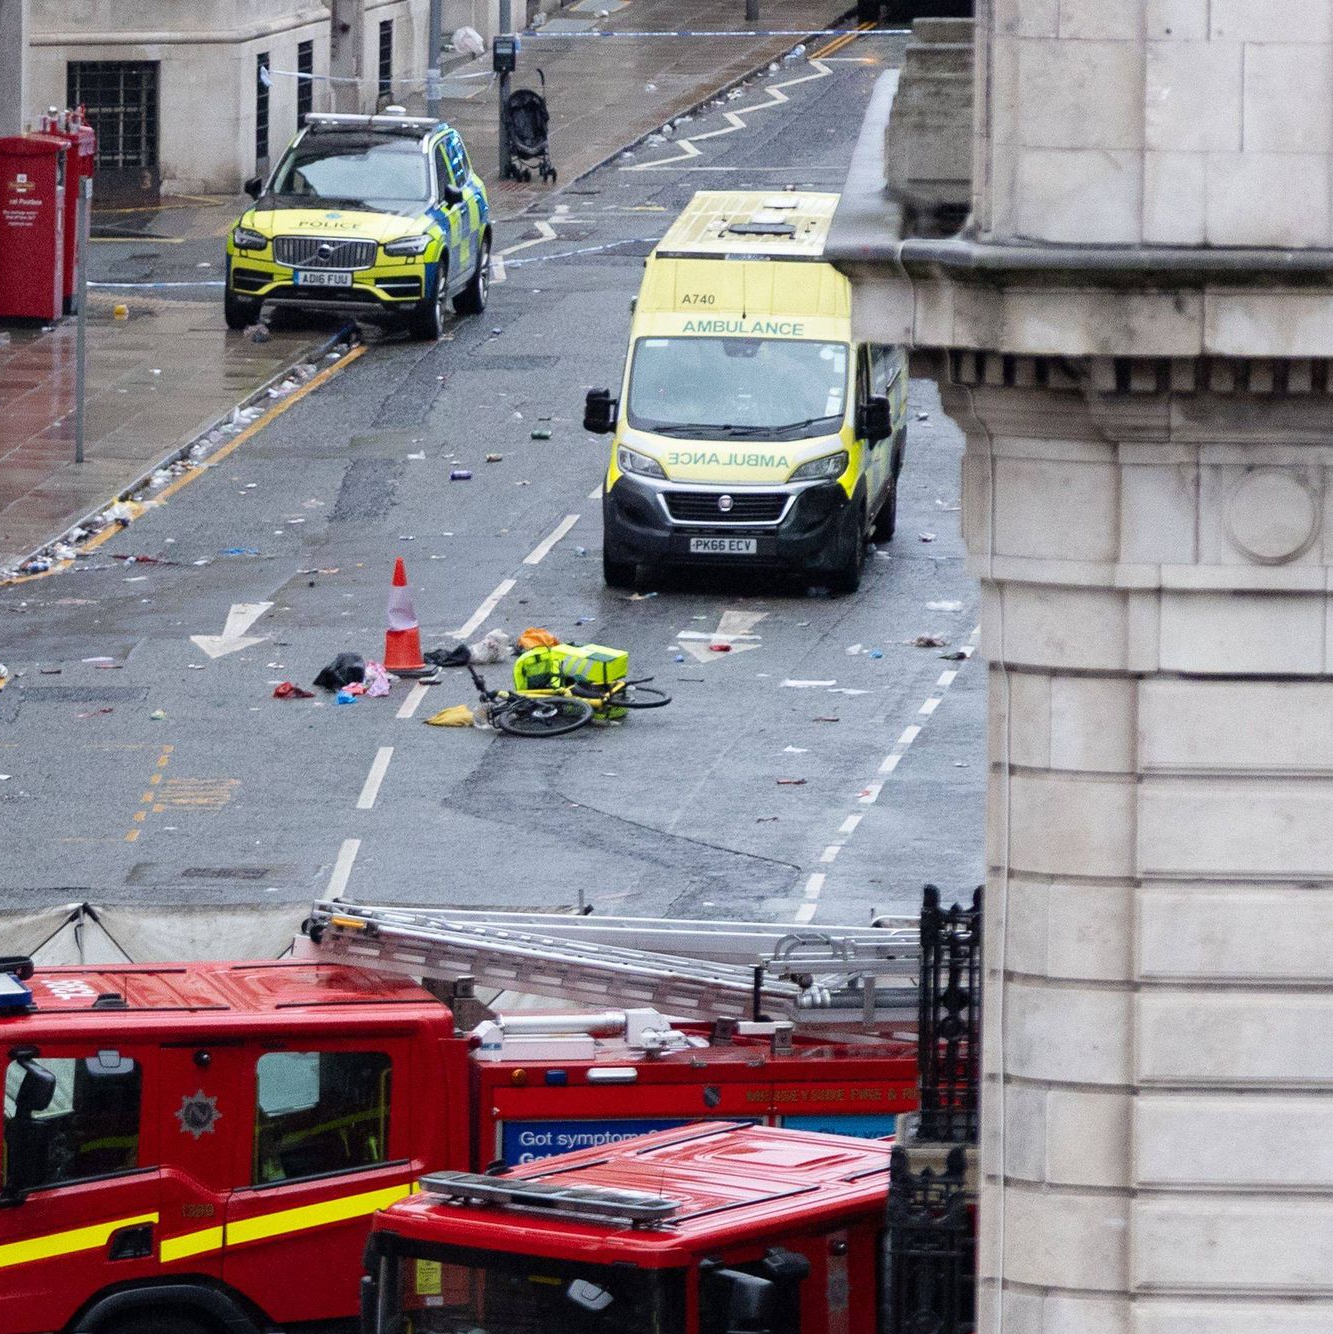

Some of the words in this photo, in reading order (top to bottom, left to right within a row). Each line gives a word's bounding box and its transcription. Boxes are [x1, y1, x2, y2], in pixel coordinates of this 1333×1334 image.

[298, 220, 361, 230] POLICE
[682, 294, 715, 305] A740
[683, 320, 805, 336] AMBULANCE
[694, 540, 726, 551] PK66
[520, 1131, 553, 1146] Got
